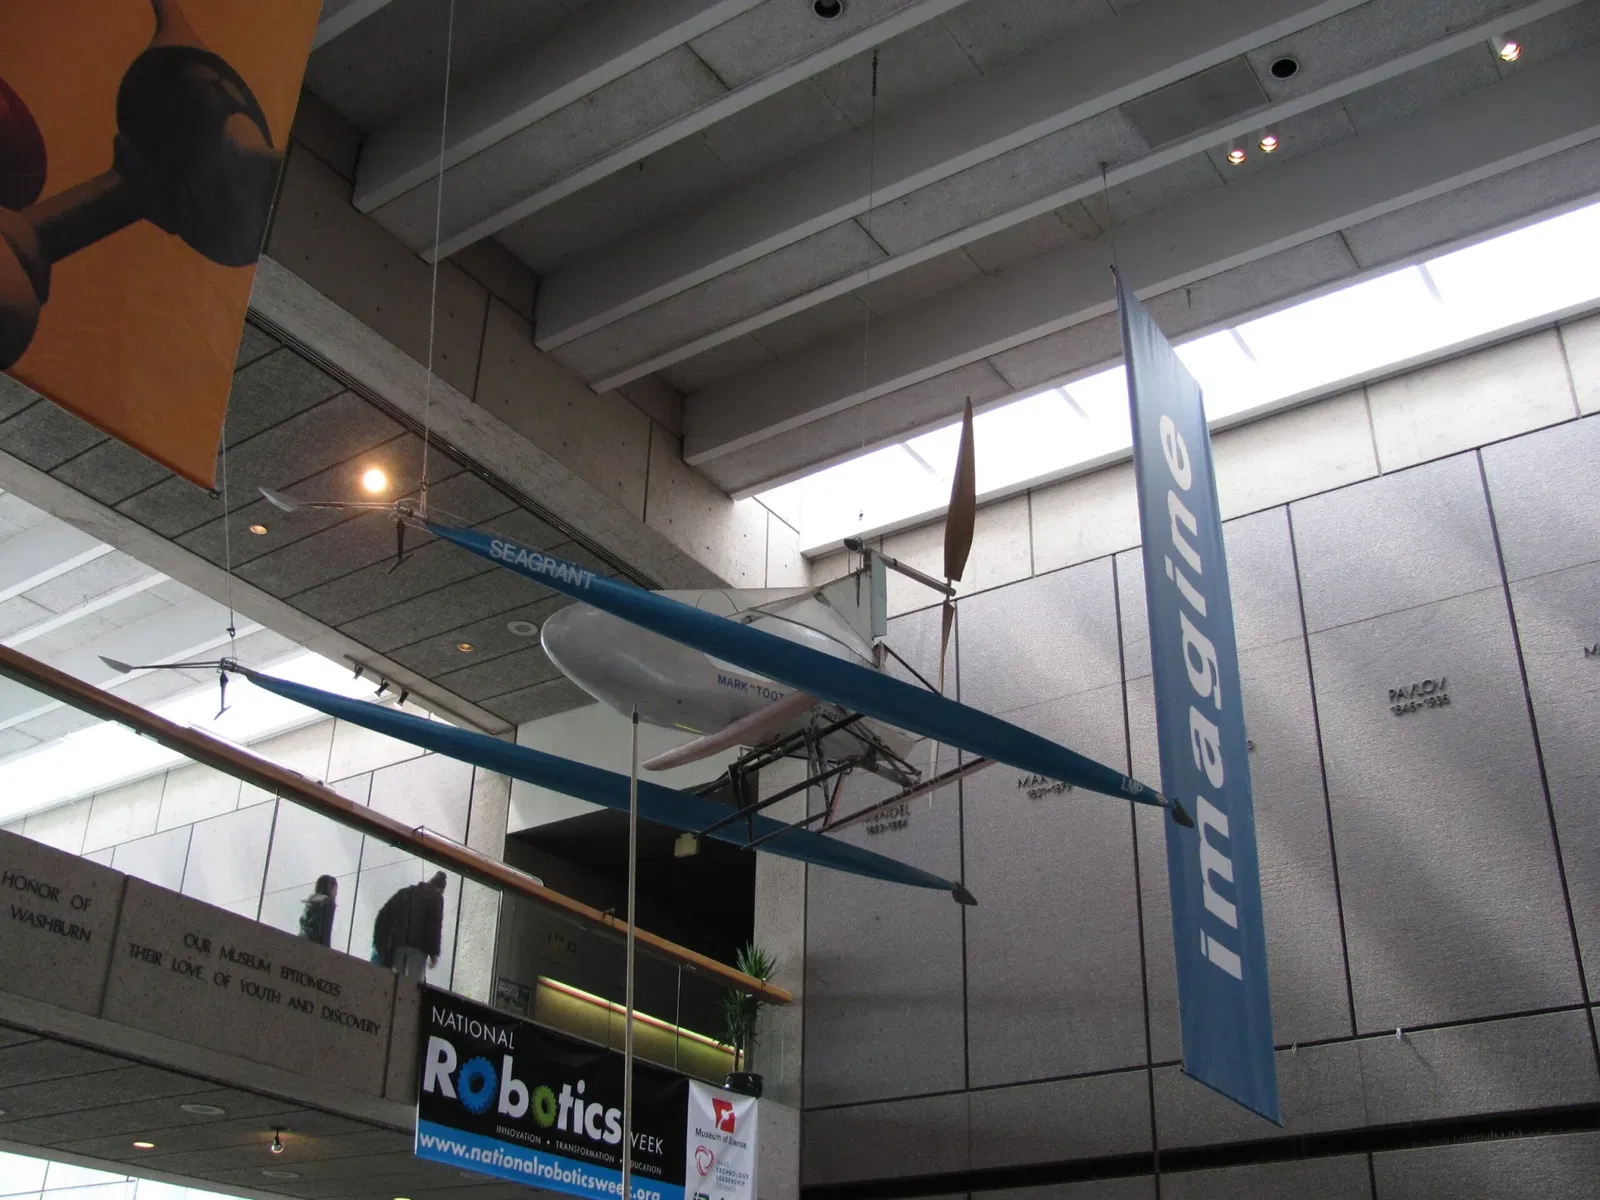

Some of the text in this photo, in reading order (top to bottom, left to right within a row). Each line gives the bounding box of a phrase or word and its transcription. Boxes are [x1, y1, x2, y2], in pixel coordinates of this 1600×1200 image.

[489, 539, 597, 589] SEAGRANT
[717, 674, 749, 692] MARK
[1158, 413, 1244, 982] imagine
[1389, 676, 1446, 703] PAVLOV
[1, 870, 93, 912] HONOR OF
[10, 903, 93, 944] WASHBURN
[183, 932, 342, 998] OUR MUSEUM EPITOMIZES
[128, 942, 164, 968] THEIR
[213, 971, 233, 989] OF
[239, 979, 282, 1004] YOUTH
[287, 997, 316, 1015] AND
[320, 1005, 381, 1036] DISCOVERY
[431, 1005, 516, 1050] NATIONAL
[423, 1035, 622, 1145] Robotics
[496, 1124, 663, 1175] INNOVATION TRANSFORMATION DUCATION
[695, 1127, 722, 1141] Museum
[722, 1136, 730, 1144] of
